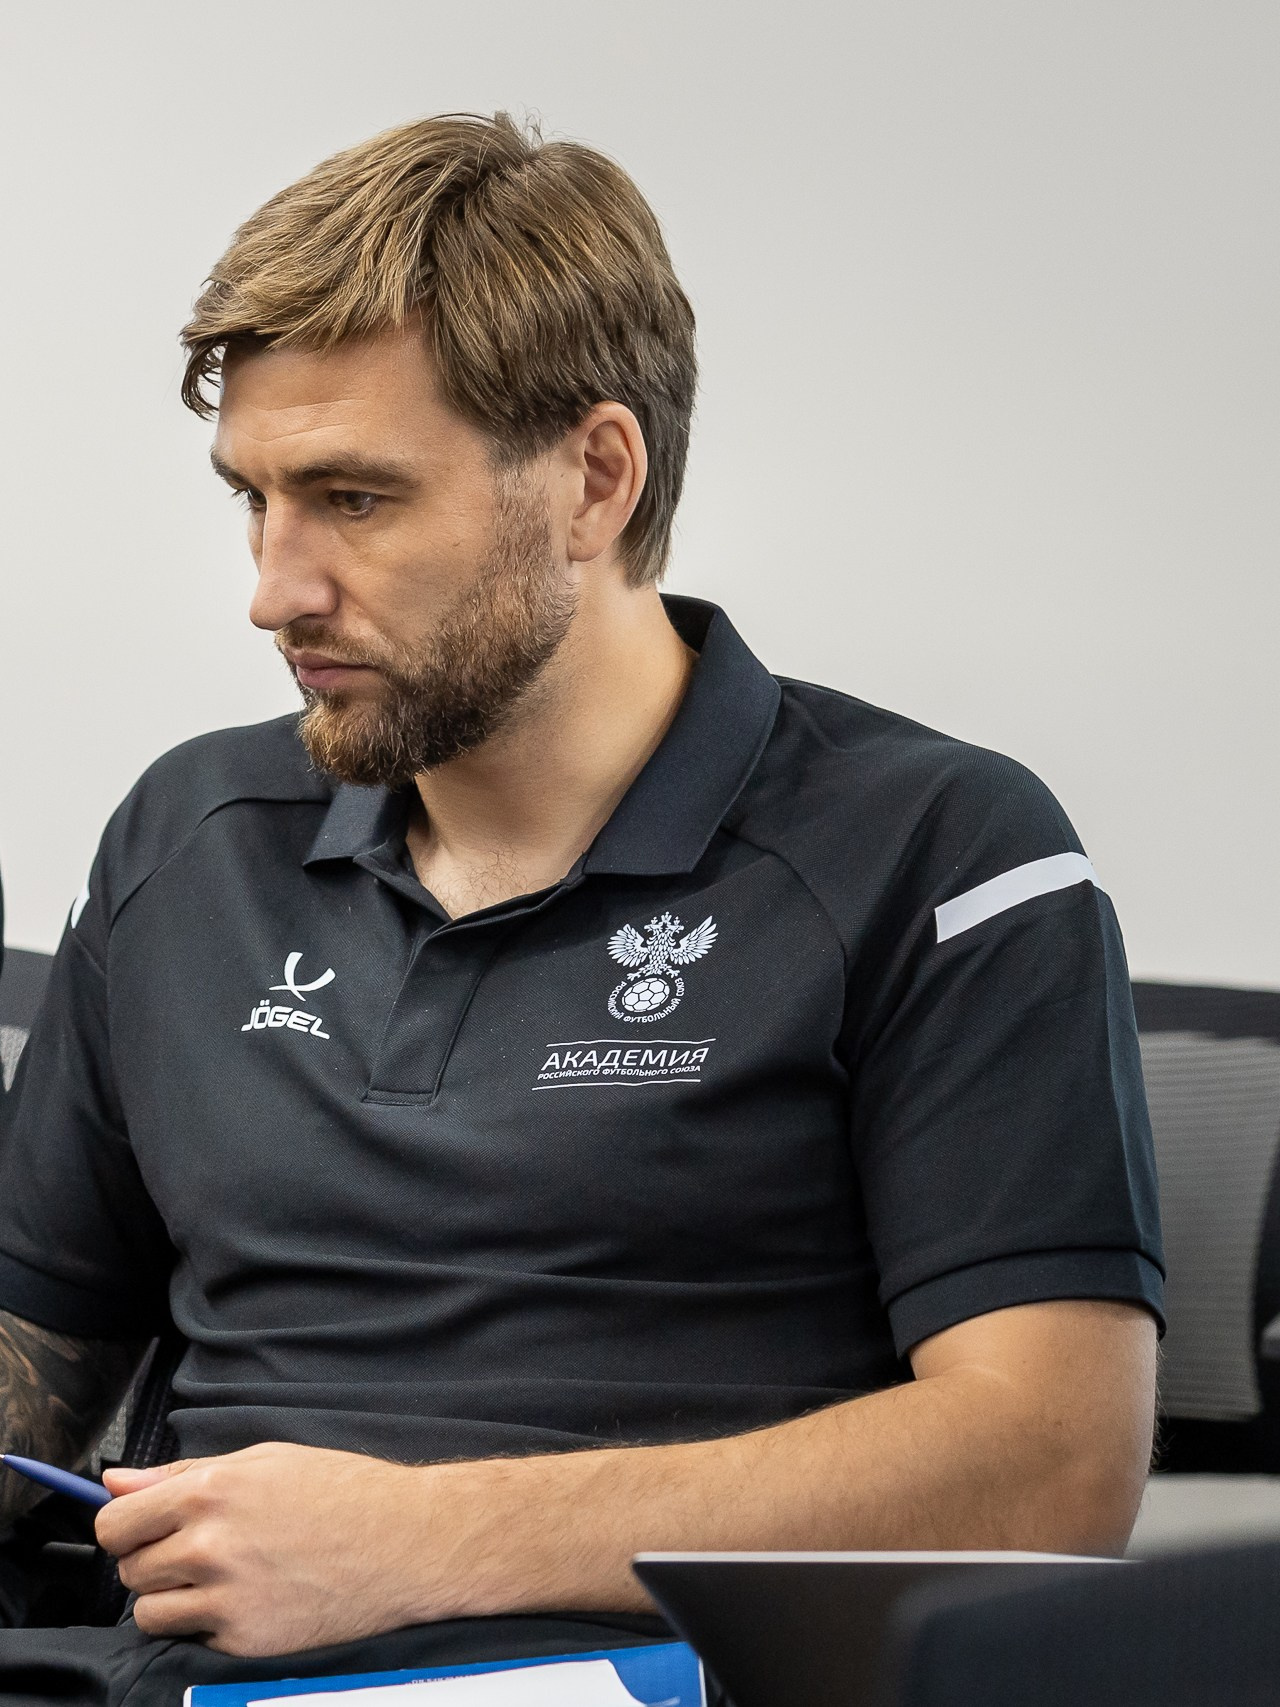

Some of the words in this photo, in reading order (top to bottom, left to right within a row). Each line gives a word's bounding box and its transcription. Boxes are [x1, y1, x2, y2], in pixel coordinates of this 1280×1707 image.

[240, 999, 330, 1040] JÖGEL
[623, 998, 681, 1023] ФУТБОЛЬНЫЙ
[541, 1047, 709, 1071] АКАДЕМИЯ
[537, 1068, 600, 1080] РОССИЙСКОГО
[602, 1068, 668, 1077] ФУТБОЛЬНОГО
[670, 1065, 701, 1074] СОЮЗА
